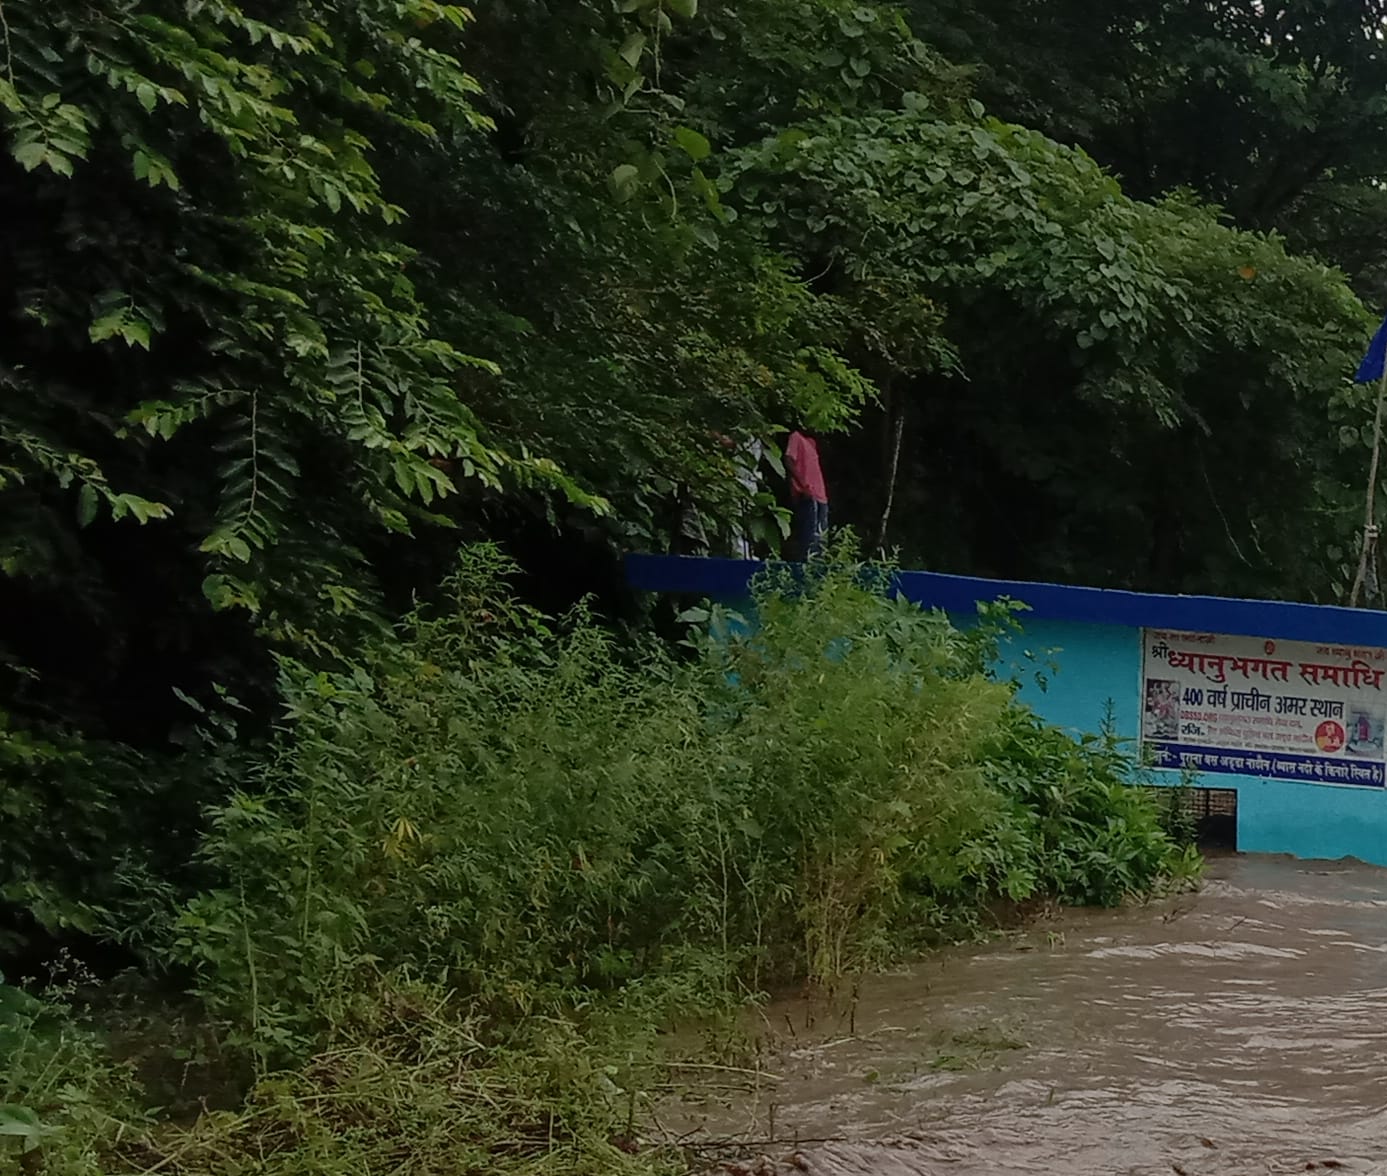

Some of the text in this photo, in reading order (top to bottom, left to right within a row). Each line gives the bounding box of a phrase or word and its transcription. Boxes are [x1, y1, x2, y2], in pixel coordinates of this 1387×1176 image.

[1152, 641, 1169, 659] श्री
[1299, 660, 1385, 691] समाधि
[1182, 684, 1344, 719] 400 वर्ष प्राचीन अमर स्थान
[1315, 761, 1324, 776] के
